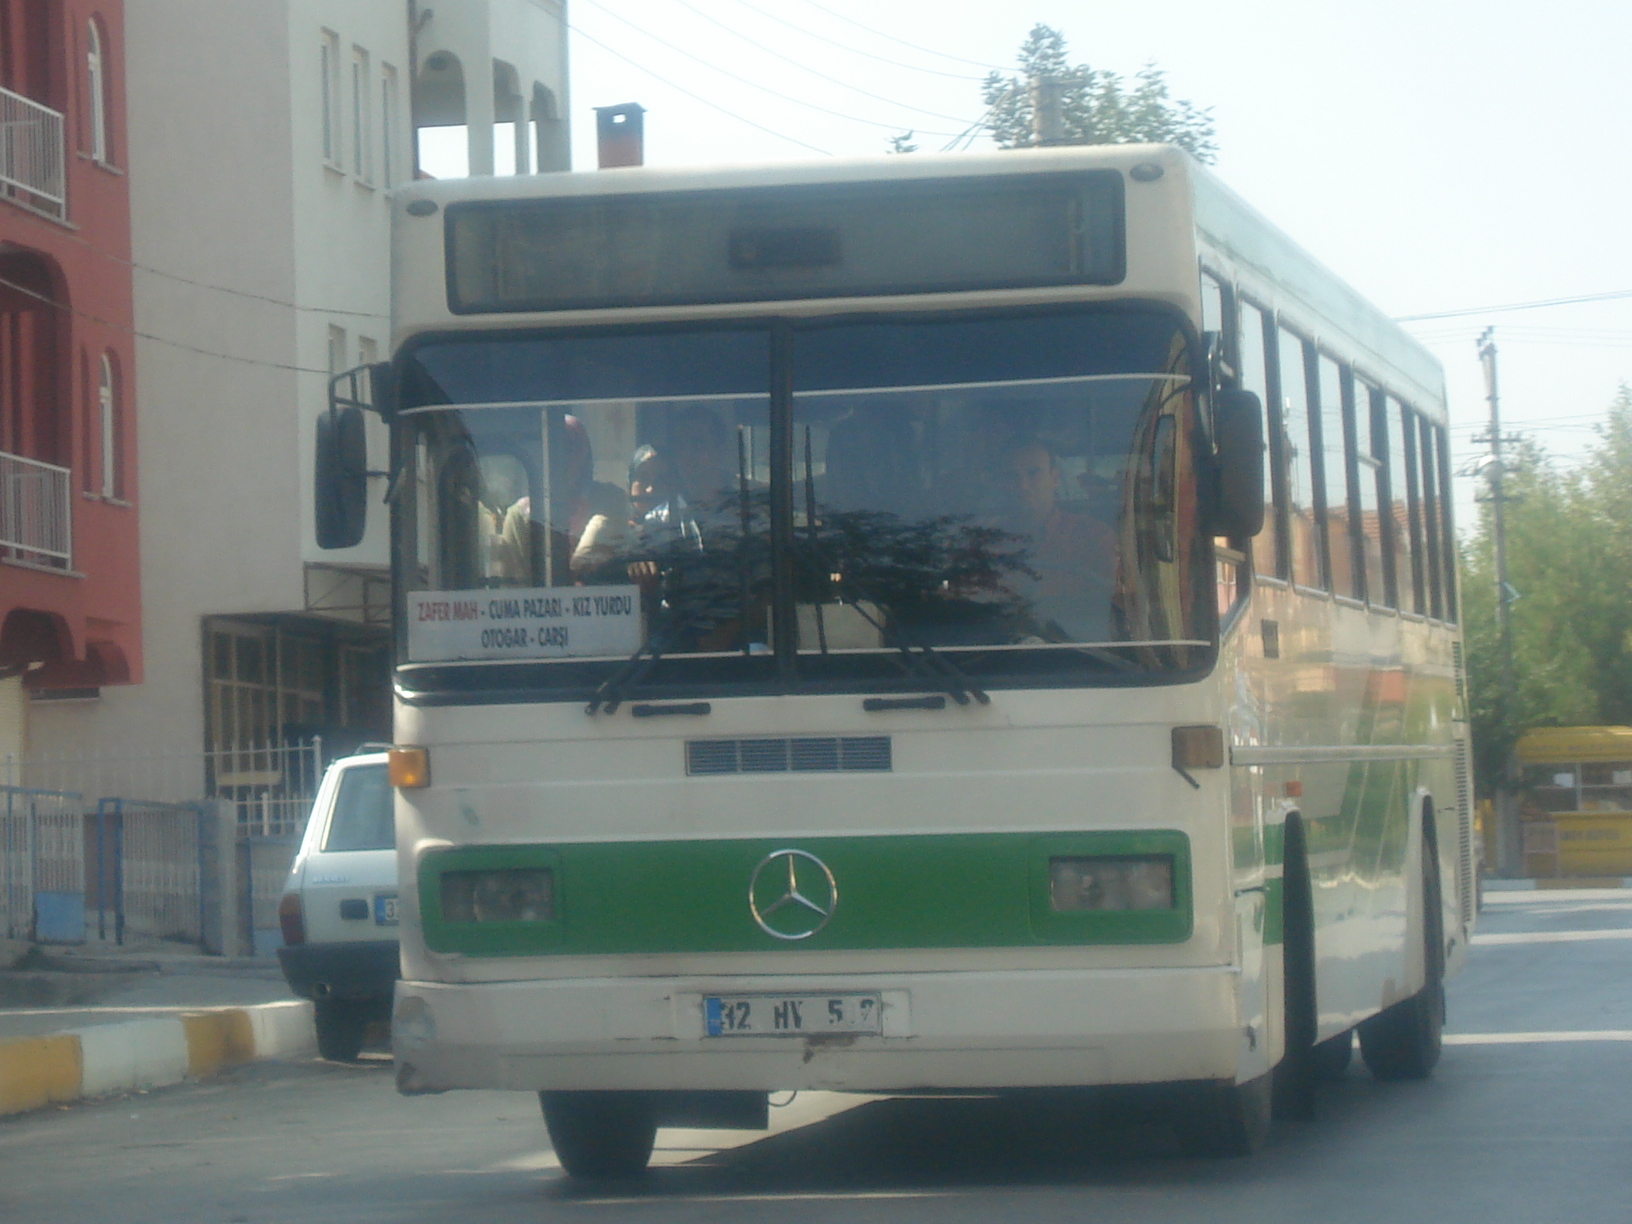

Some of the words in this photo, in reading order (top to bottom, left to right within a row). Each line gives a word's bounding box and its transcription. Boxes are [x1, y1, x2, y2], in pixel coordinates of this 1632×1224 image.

[418, 602, 450, 621] ZAFER
[452, 600, 478, 620] MAH
[523, 597, 562, 618] PAZARI
[572, 596, 592, 616] KIZ
[593, 595, 632, 615] YURDU
[481, 628, 528, 648] OTOGAR
